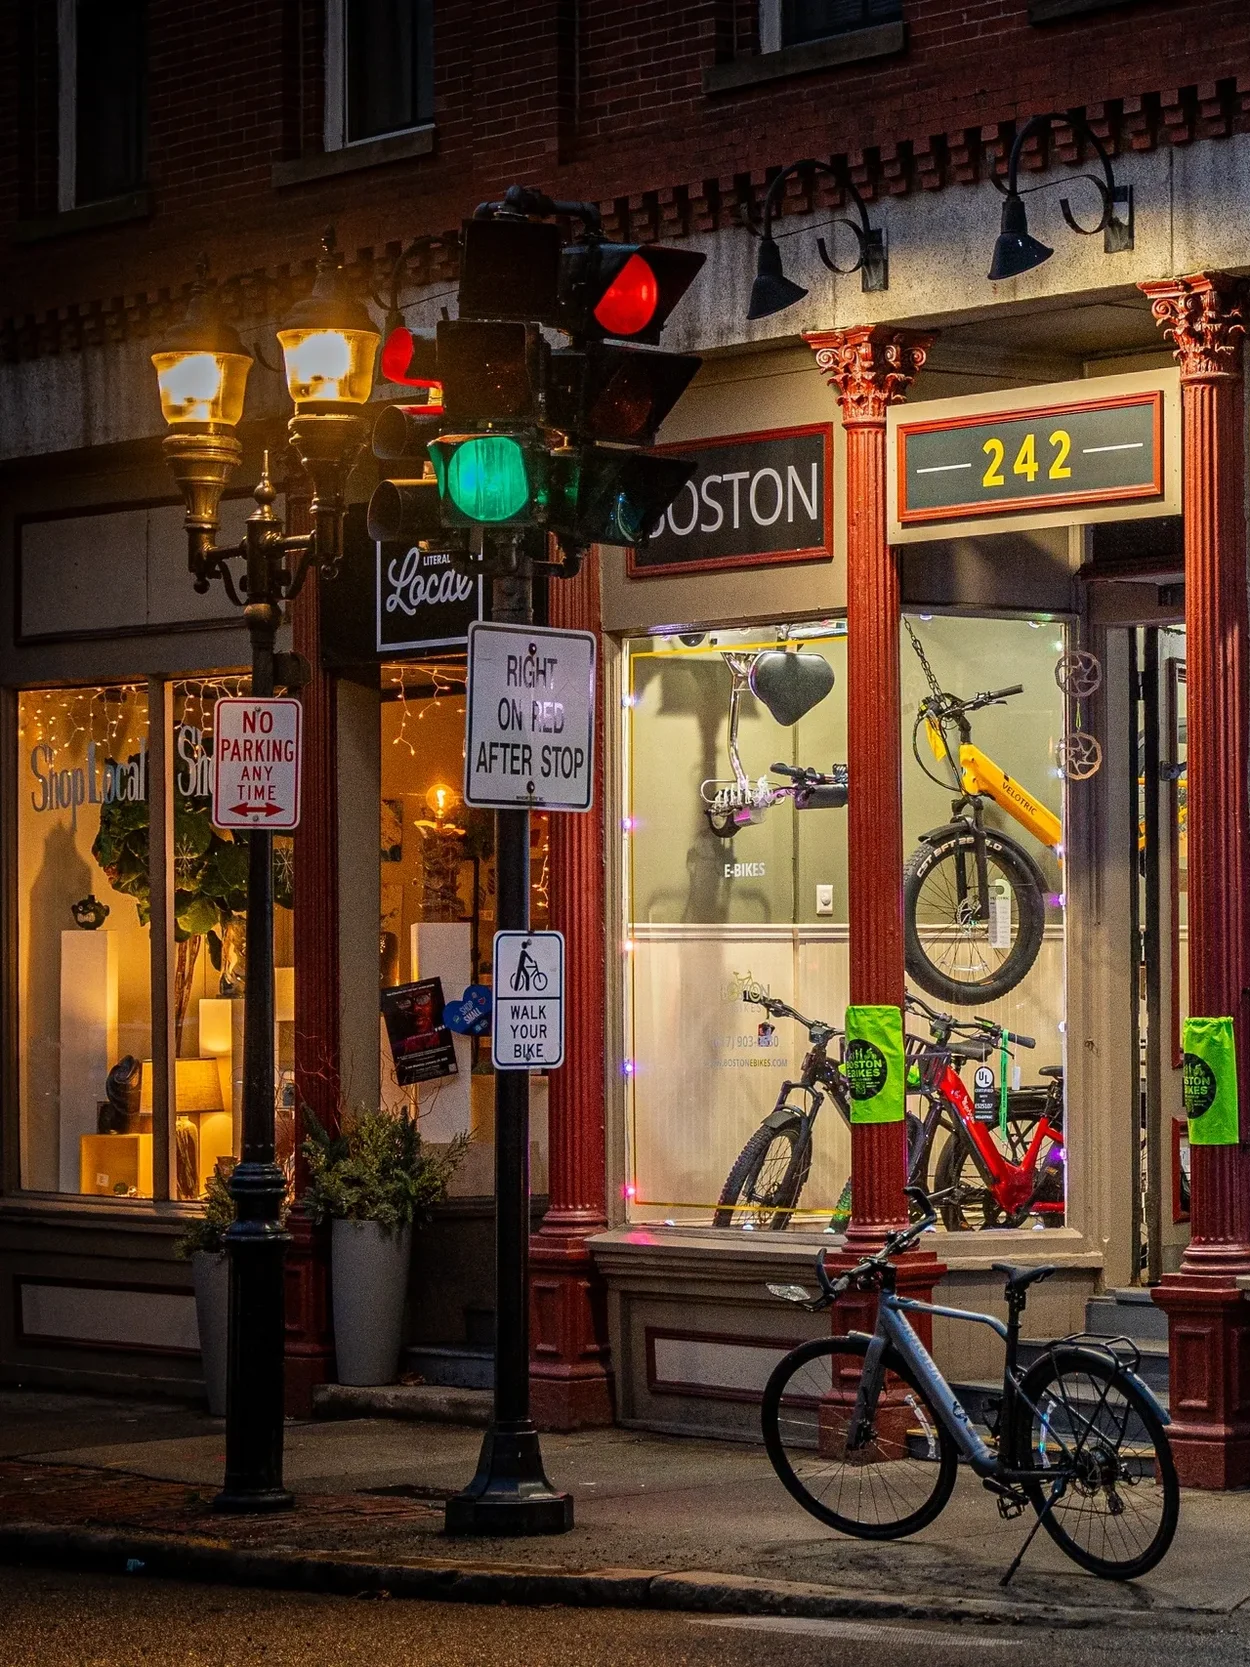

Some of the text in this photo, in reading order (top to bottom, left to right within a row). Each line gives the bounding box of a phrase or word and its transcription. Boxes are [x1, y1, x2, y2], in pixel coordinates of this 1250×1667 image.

[982, 429, 1071, 487] 242
[506, 655, 558, 690] RIGHT
[242, 711, 274, 733] NO
[497, 697, 565, 734] ON RED
[220, 739, 294, 762] PARKING
[476, 741, 584, 779] AFTER STOP
[241, 765, 274, 781] ANY
[30, 744, 85, 832] Shop
[86, 737, 146, 805] Local
[237, 784, 276, 800] TIME
[1002, 781, 1038, 817] VELOTRIC
[724, 862, 766, 878] E-BIKES
[460, 1000, 474, 1015] SHOP
[464, 1007, 482, 1024] SMALL
[510, 1005, 547, 1020] WALK
[510, 1024, 547, 1039] YOUR
[514, 1043, 544, 1058] BIKE
[847, 1060, 883, 1069] BOSTON
[848, 1068, 881, 1077] EBIKES
[979, 1071, 990, 1084] UL
